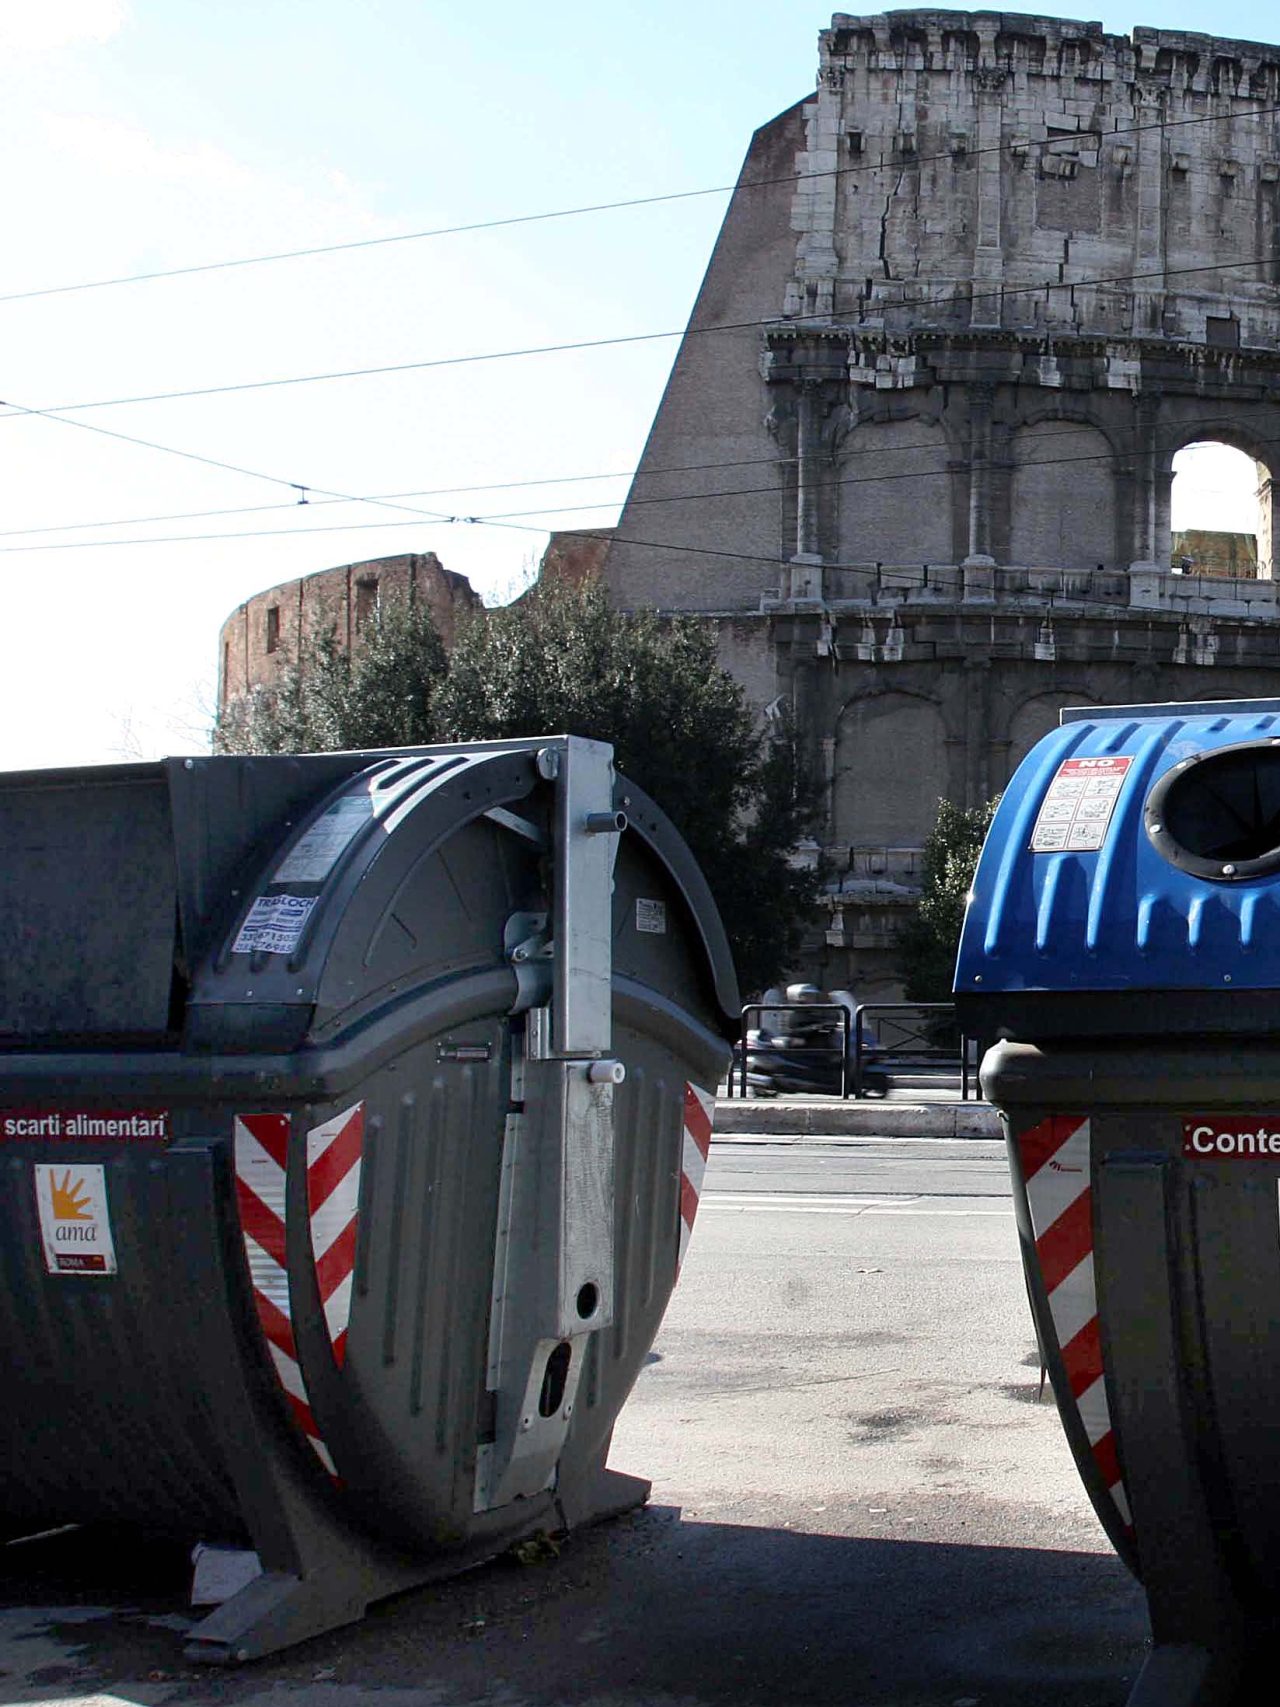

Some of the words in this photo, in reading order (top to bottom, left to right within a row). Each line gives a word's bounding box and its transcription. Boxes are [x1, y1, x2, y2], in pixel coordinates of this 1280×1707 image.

[4, 1114, 60, 1136] scarti
[65, 1114, 165, 1136] alimentari
[55, 1225, 96, 1241] ama
